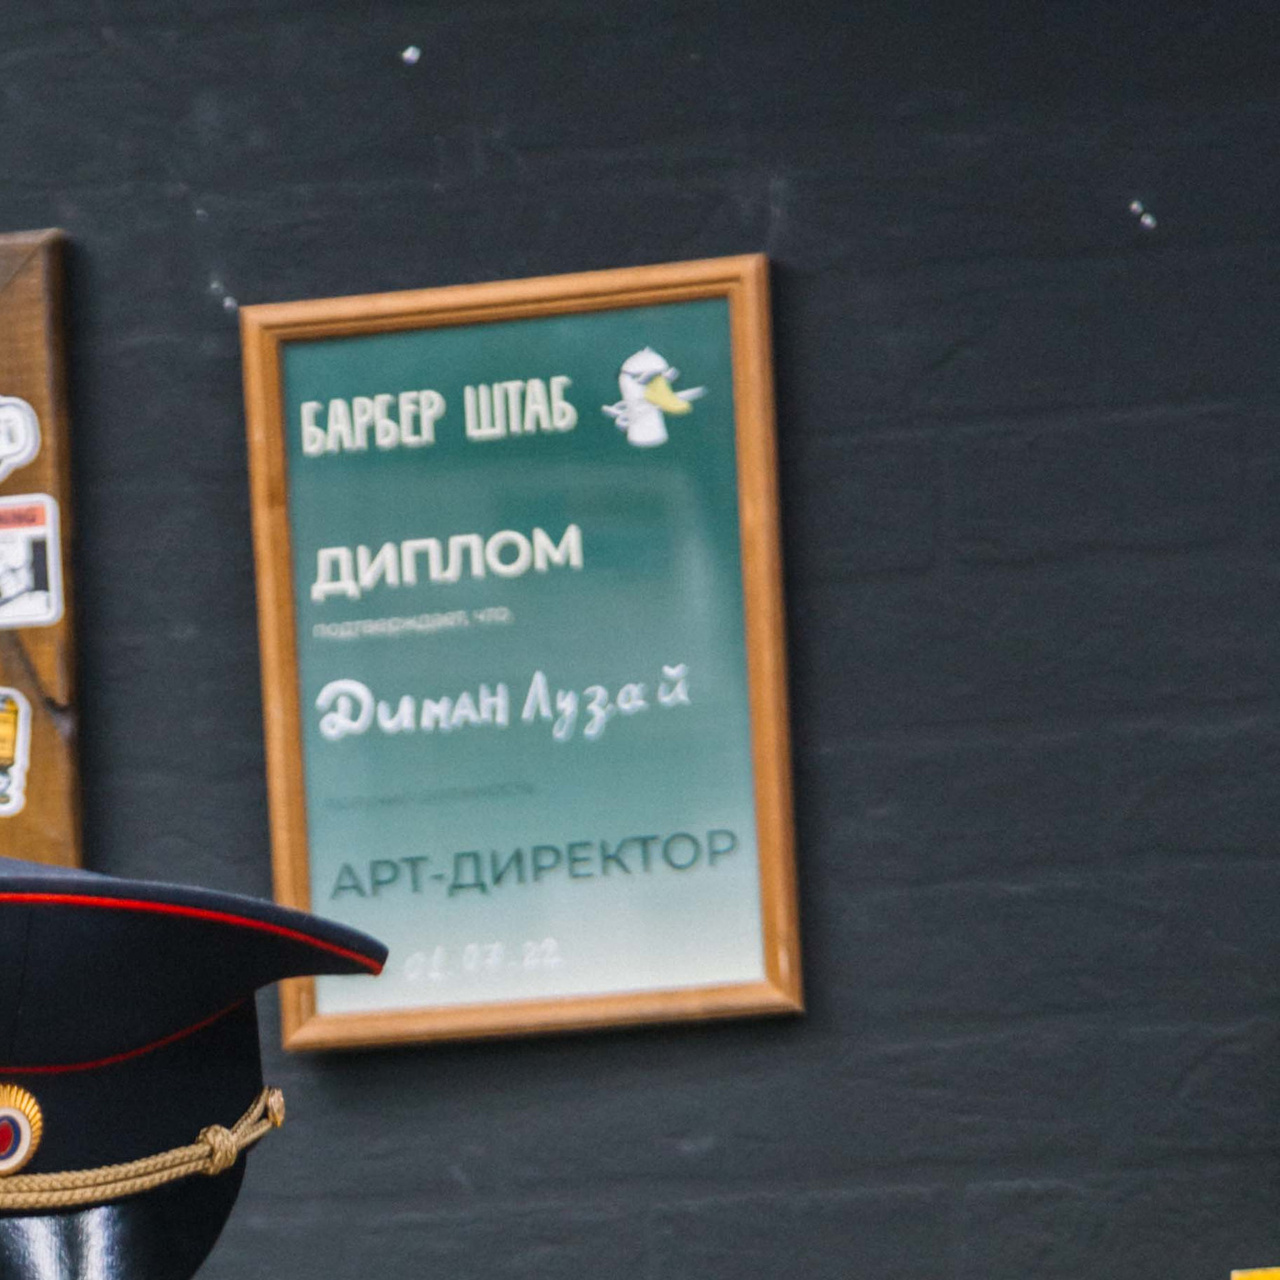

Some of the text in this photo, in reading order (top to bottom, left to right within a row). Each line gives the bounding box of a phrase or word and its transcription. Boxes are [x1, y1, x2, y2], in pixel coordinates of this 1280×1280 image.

[300, 375, 578, 457] БАРБЕР ШТАБ
[311, 524, 583, 602] ДИПЛОМ
[330, 827, 739, 902] АРТ-ДИРЕКТОР
